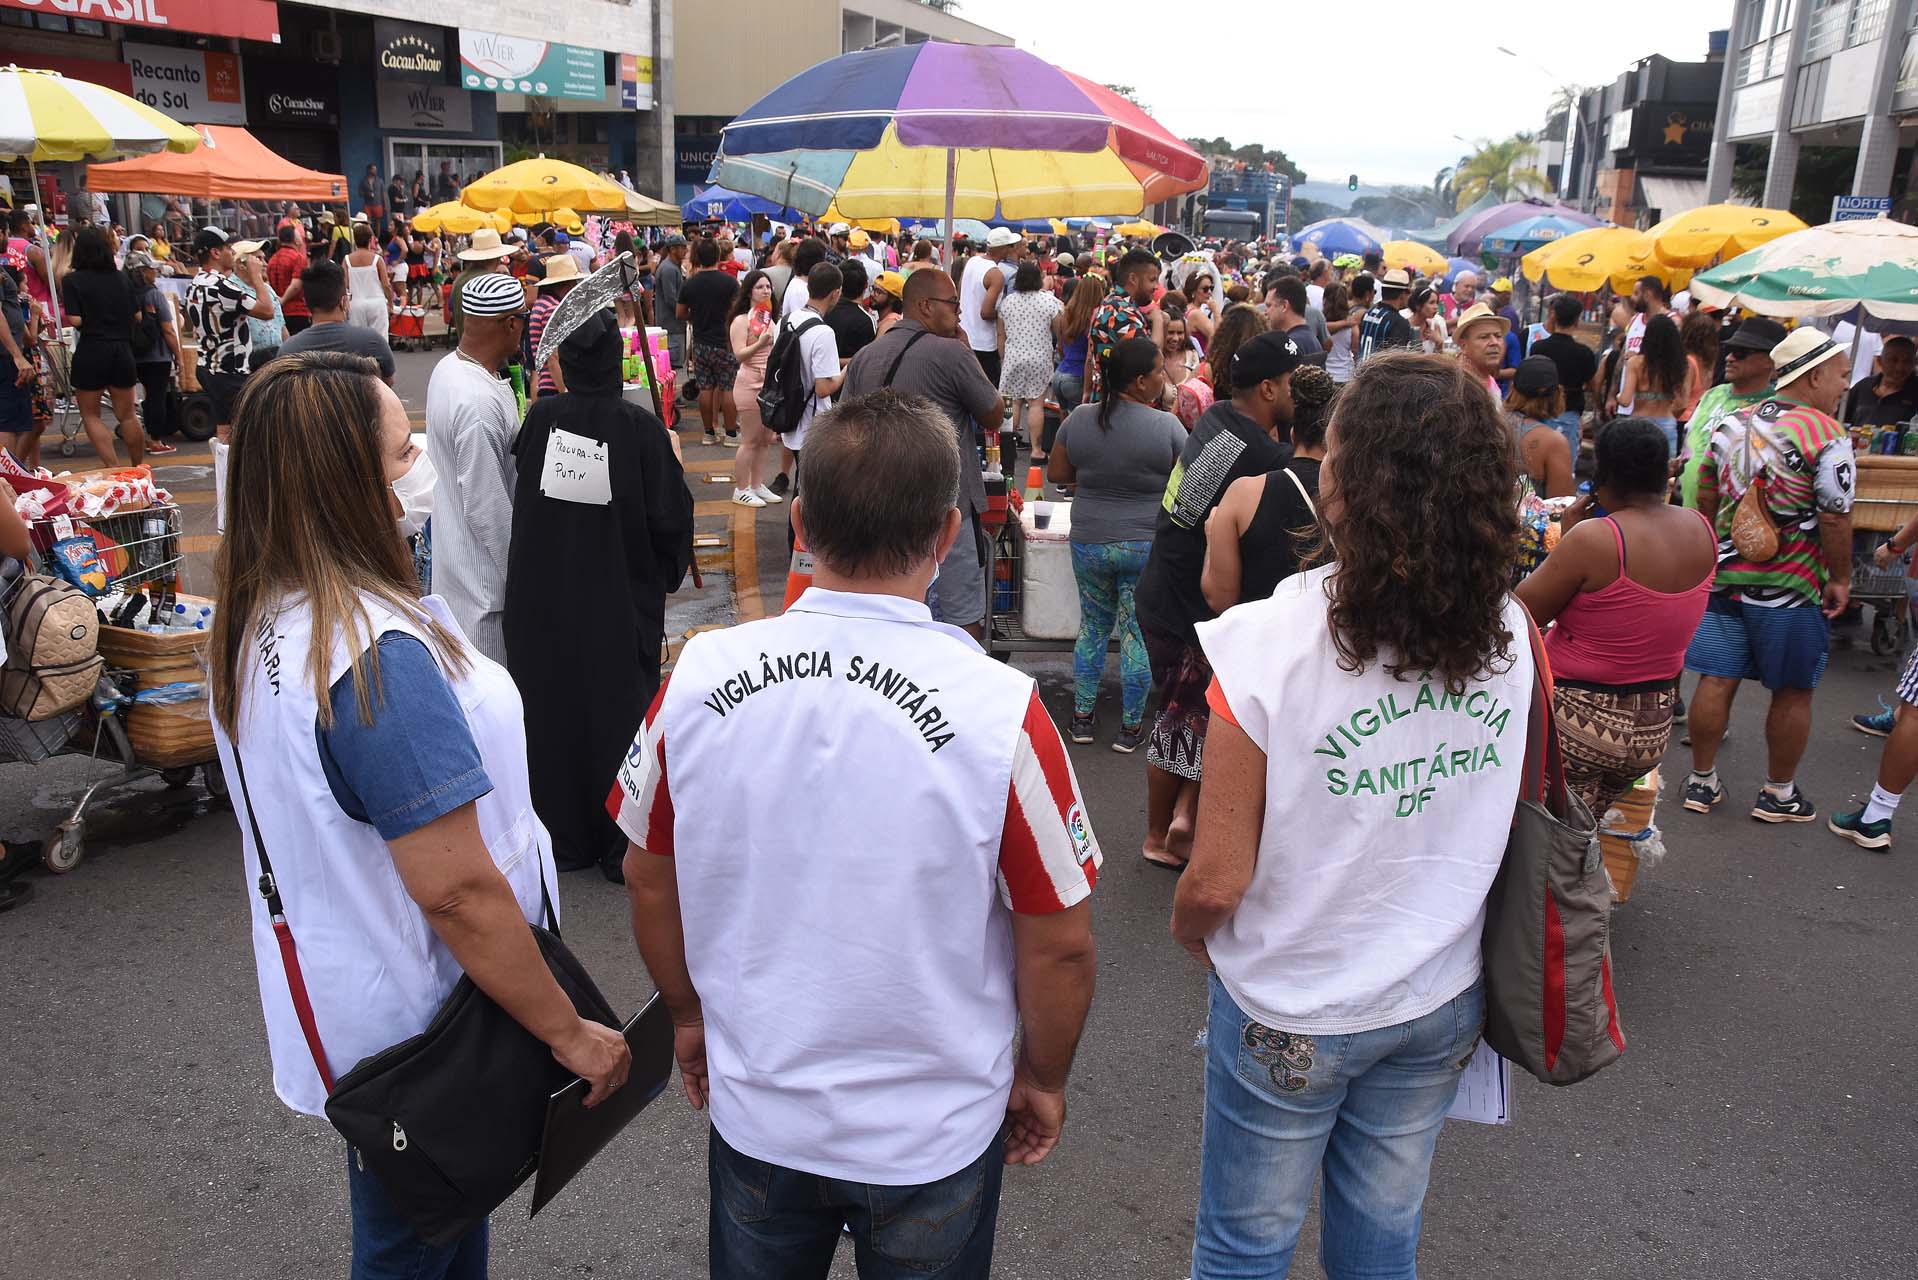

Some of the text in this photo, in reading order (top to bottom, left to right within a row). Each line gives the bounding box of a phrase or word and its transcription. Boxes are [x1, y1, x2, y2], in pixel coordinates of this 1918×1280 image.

[131, 58, 201, 84] Recanto
[136, 88, 190, 110] do Sol
[1839, 197, 1889, 209] NORTE
[555, 462, 587, 481] PUTIN
[703, 650, 956, 753] VIGILÂNCIA SANITÁRIA
[1313, 671, 1512, 760] VIGILÂNCIA
[1326, 742, 1502, 796] SANITÁRIA
[1395, 786, 1436, 818] DF
